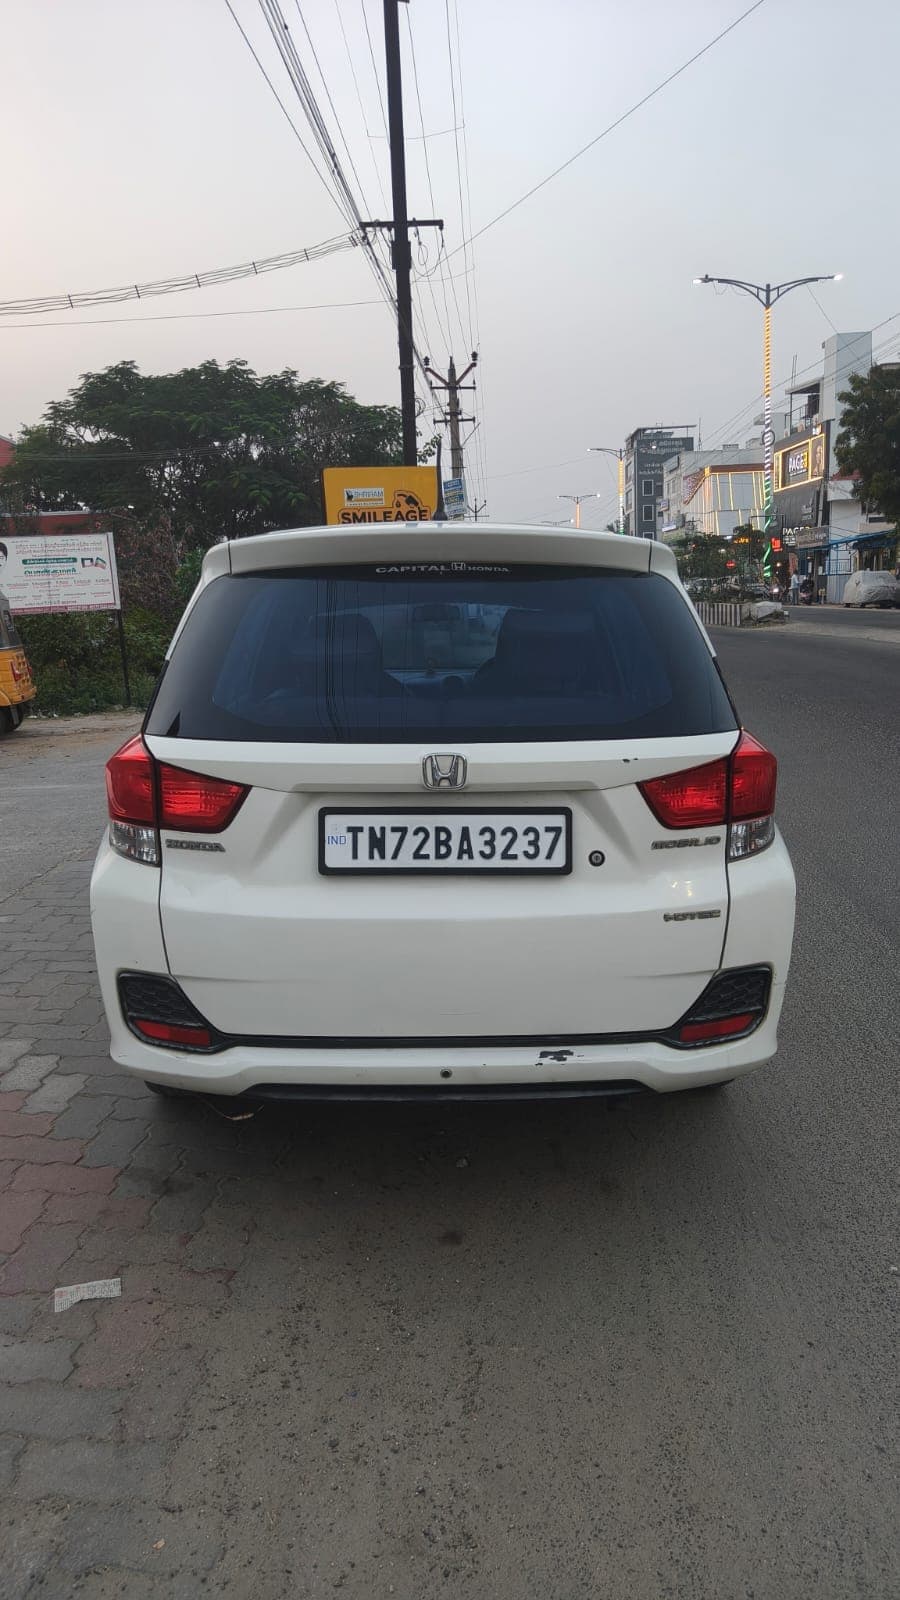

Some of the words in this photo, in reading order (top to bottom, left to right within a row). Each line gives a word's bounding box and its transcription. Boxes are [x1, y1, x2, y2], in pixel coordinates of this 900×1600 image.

[341, 509, 429, 524] SMILEAGE
[375, 565, 450, 573] CAPITAL
[327, 835, 347, 846] IND
[346, 826, 563, 861] TN72BA3237
